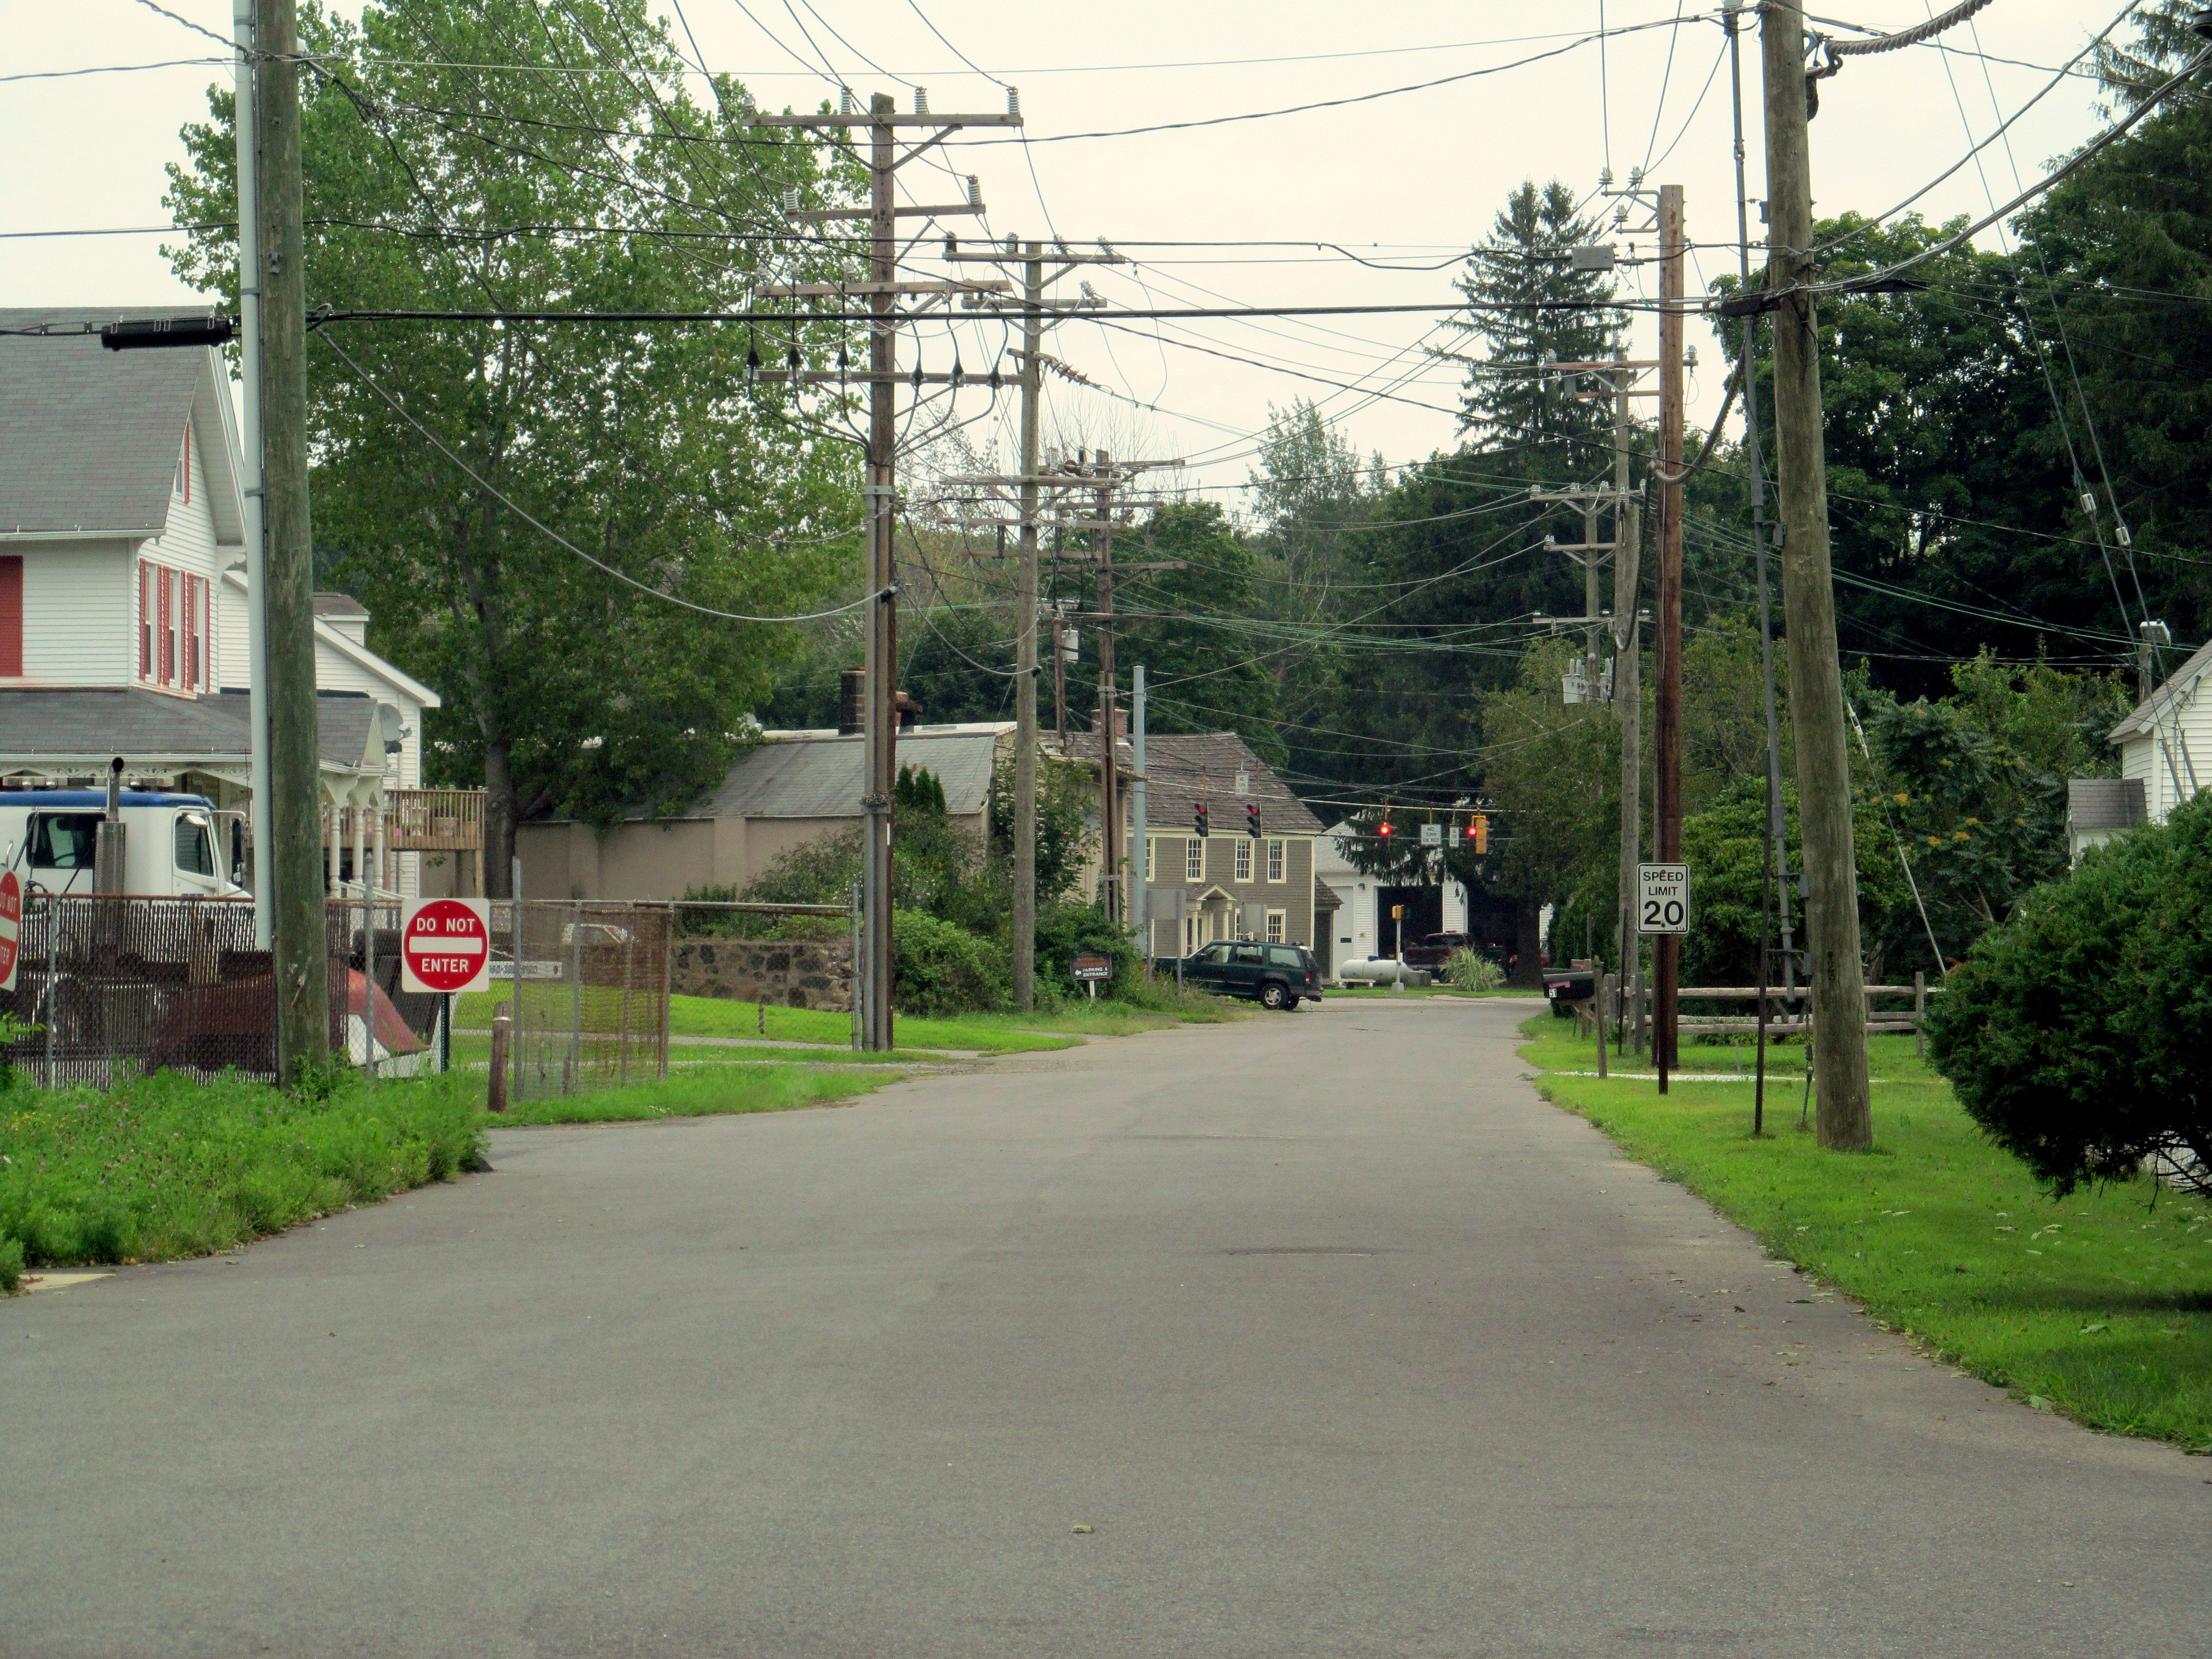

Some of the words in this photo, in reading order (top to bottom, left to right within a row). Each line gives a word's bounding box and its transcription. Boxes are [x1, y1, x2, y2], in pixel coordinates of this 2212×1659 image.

[1643, 871, 1684, 881] SPEED
[1648, 886, 1678, 896] LIMIT
[7, 895, 17, 913] NOT
[1644, 900, 1684, 925] 20
[416, 918, 436, 932] DO
[446, 918, 475, 932] NOT
[421, 958, 469, 972] ENTER
[1549, 989, 1557, 997] 51
